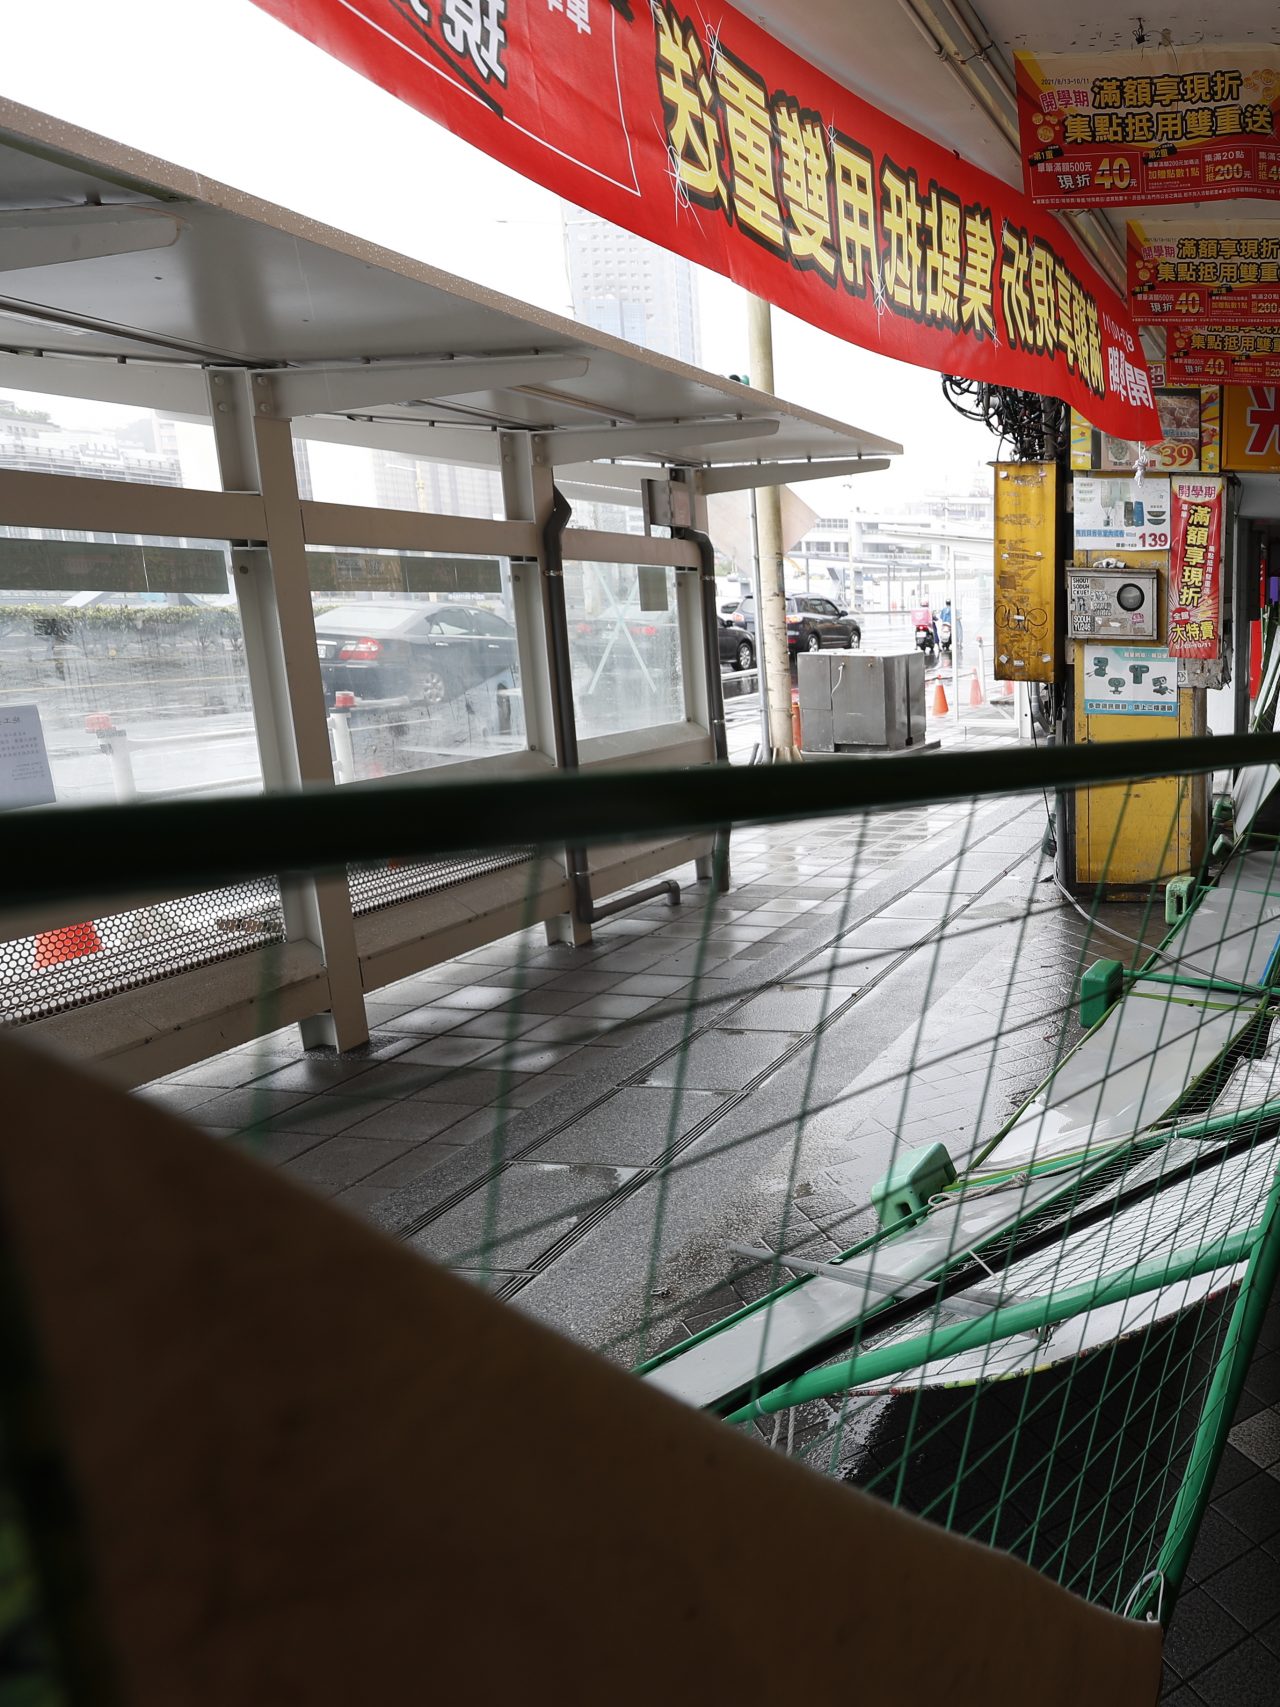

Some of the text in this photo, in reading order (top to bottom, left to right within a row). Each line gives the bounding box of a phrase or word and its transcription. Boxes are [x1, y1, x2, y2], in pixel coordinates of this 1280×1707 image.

[1092, 70, 1243, 109] 滿額享現折
[1039, 89, 1089, 113] 開學期
[1064, 105, 1274, 144] 集點抵用雙重送
[1204, 152, 1244, 161] 集滿20點
[1177, 238, 1280, 259] 滿額享現折
[1178, 484, 1216, 499] 開學期
[1139, 533, 1168, 547] 139
[1180, 505, 1211, 607] 滿額享現折
[1172, 621, 1214, 642] 大特賣
